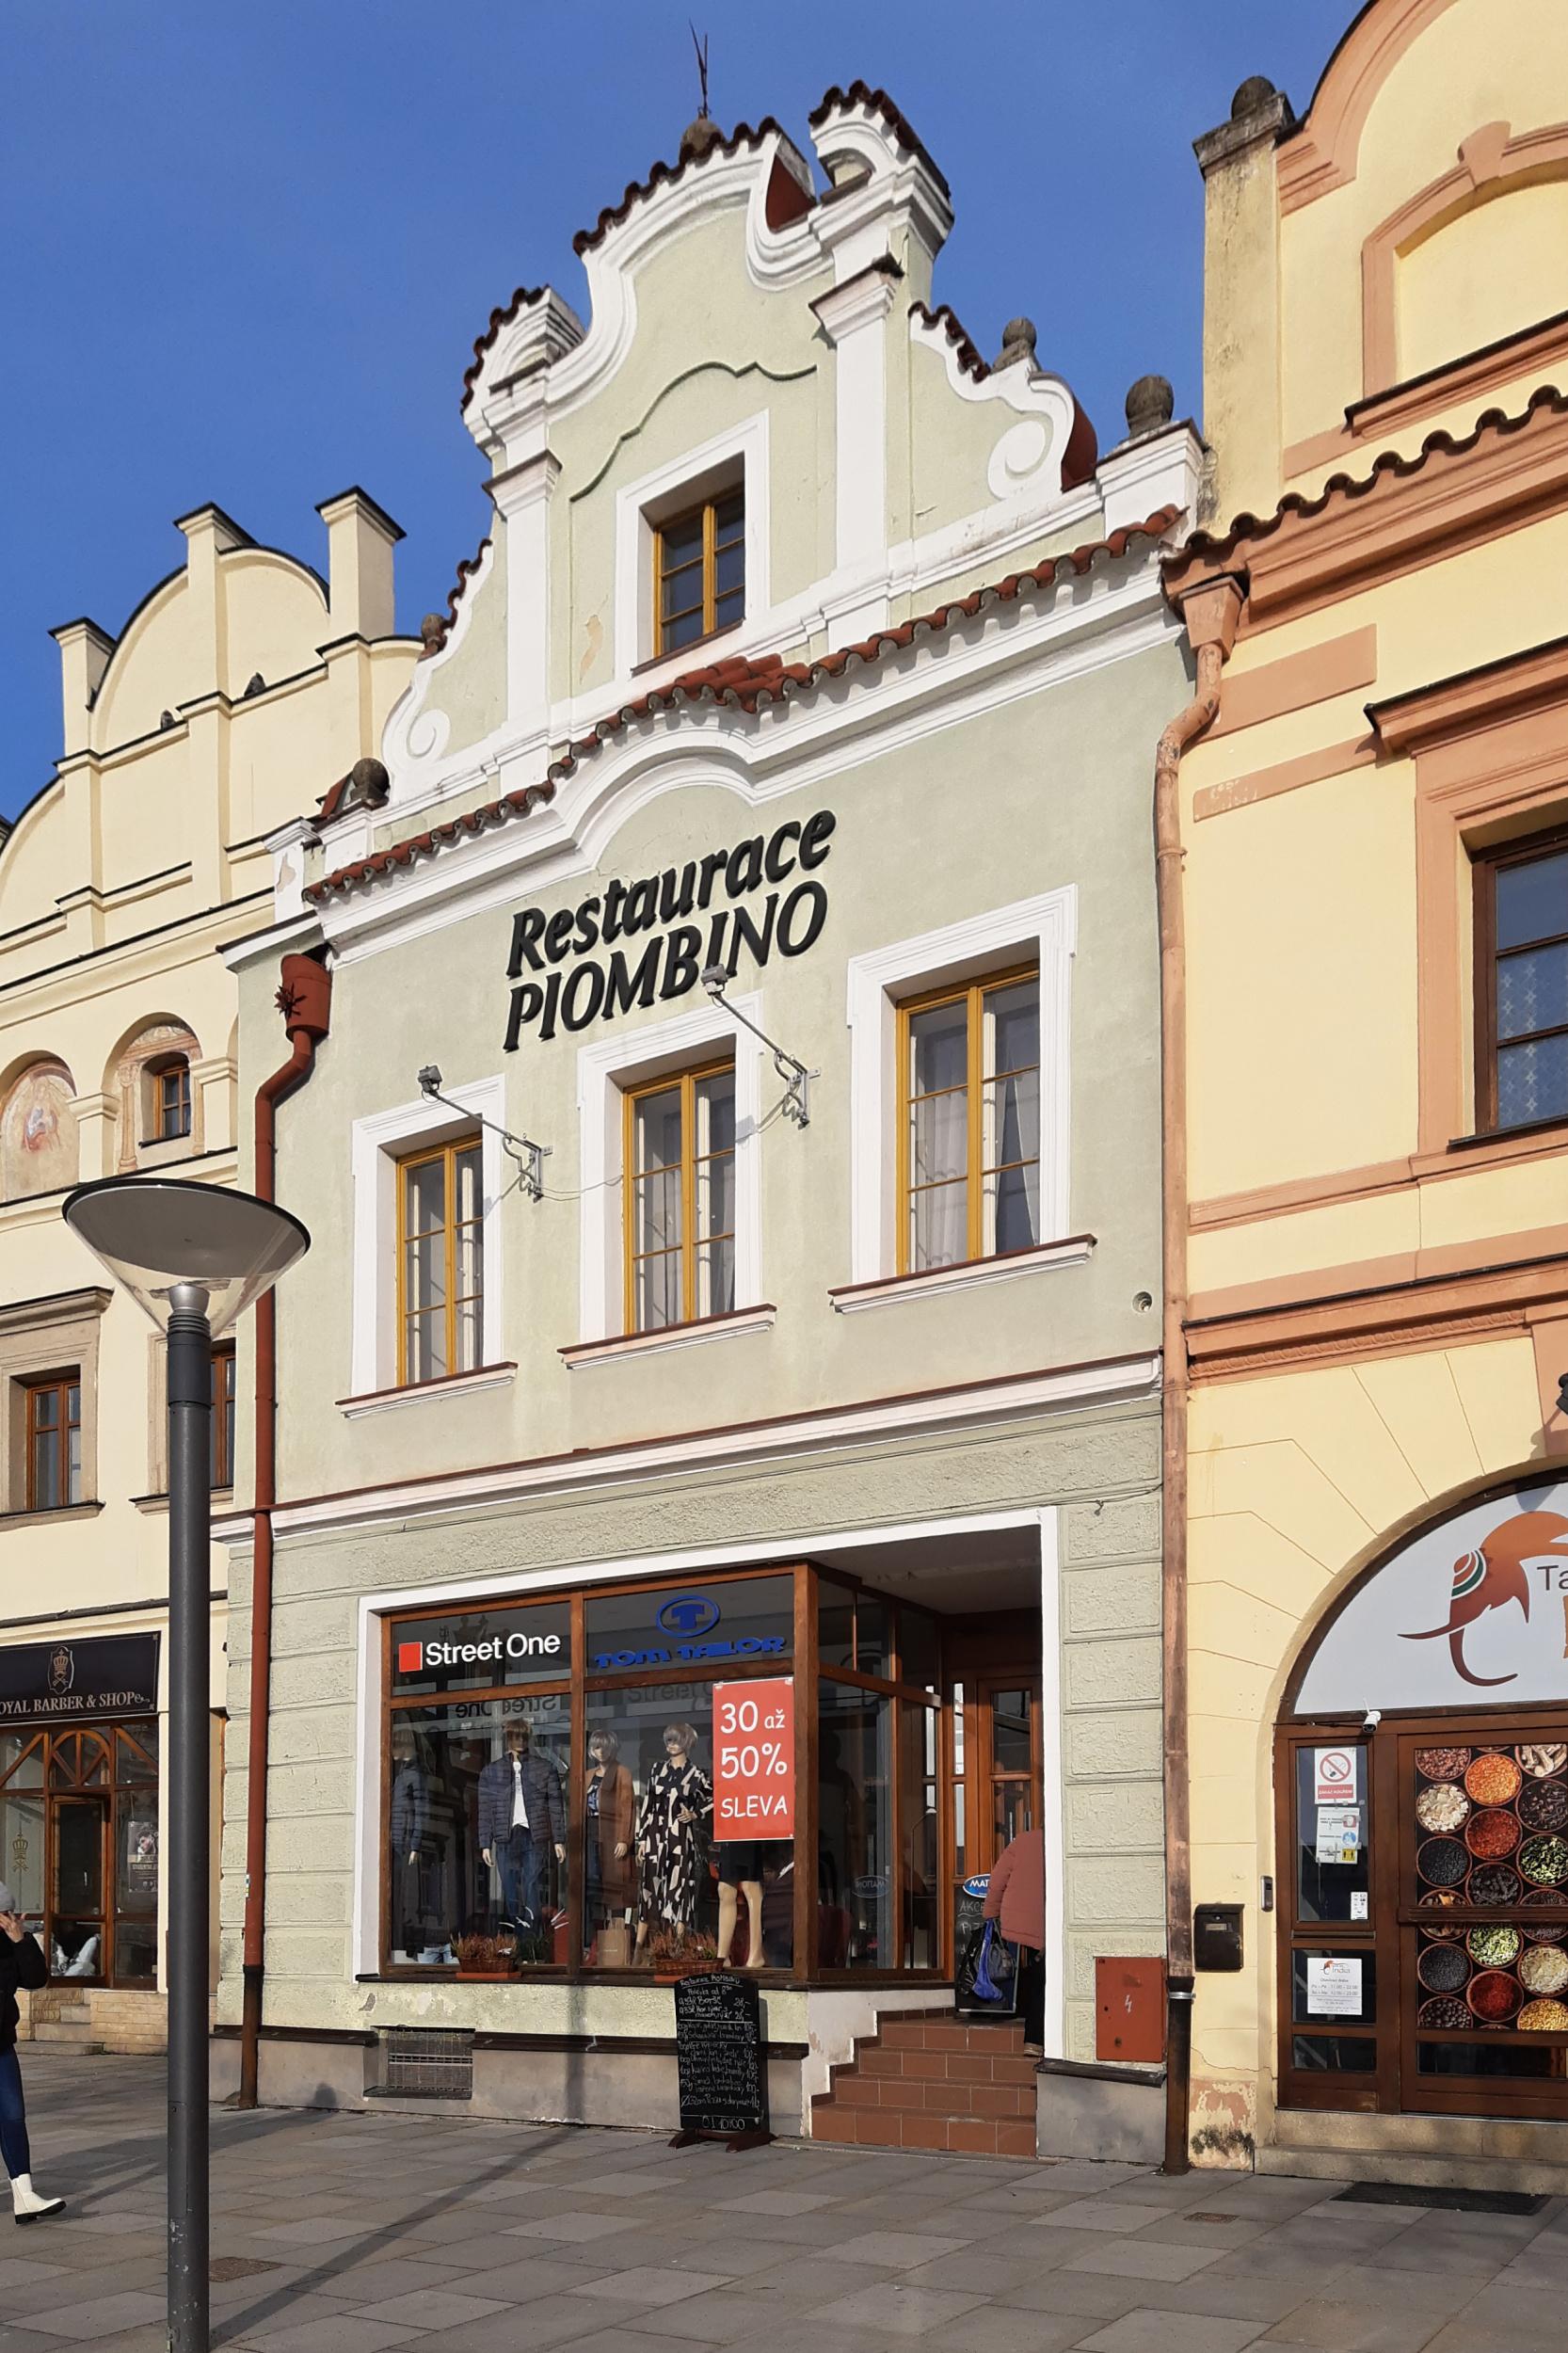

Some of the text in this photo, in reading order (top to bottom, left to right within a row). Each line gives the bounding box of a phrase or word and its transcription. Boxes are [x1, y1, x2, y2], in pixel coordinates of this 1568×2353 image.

[505, 809, 837, 980] Restaurace
[503, 880, 828, 1053] PIOMBINO
[1536, 1565, 1568, 1592] Ta
[425, 1633, 561, 1666] Street One
[594, 1637, 786, 1669] TOM TAILOR
[0, 1691, 135, 1715] OYAL BARBER & SHOP
[720, 1701, 786, 1734] 30 až
[720, 1742, 788, 1779] 50%
[720, 1795, 788, 1818] SLEVA
[969, 1880, 990, 1888] MAT
